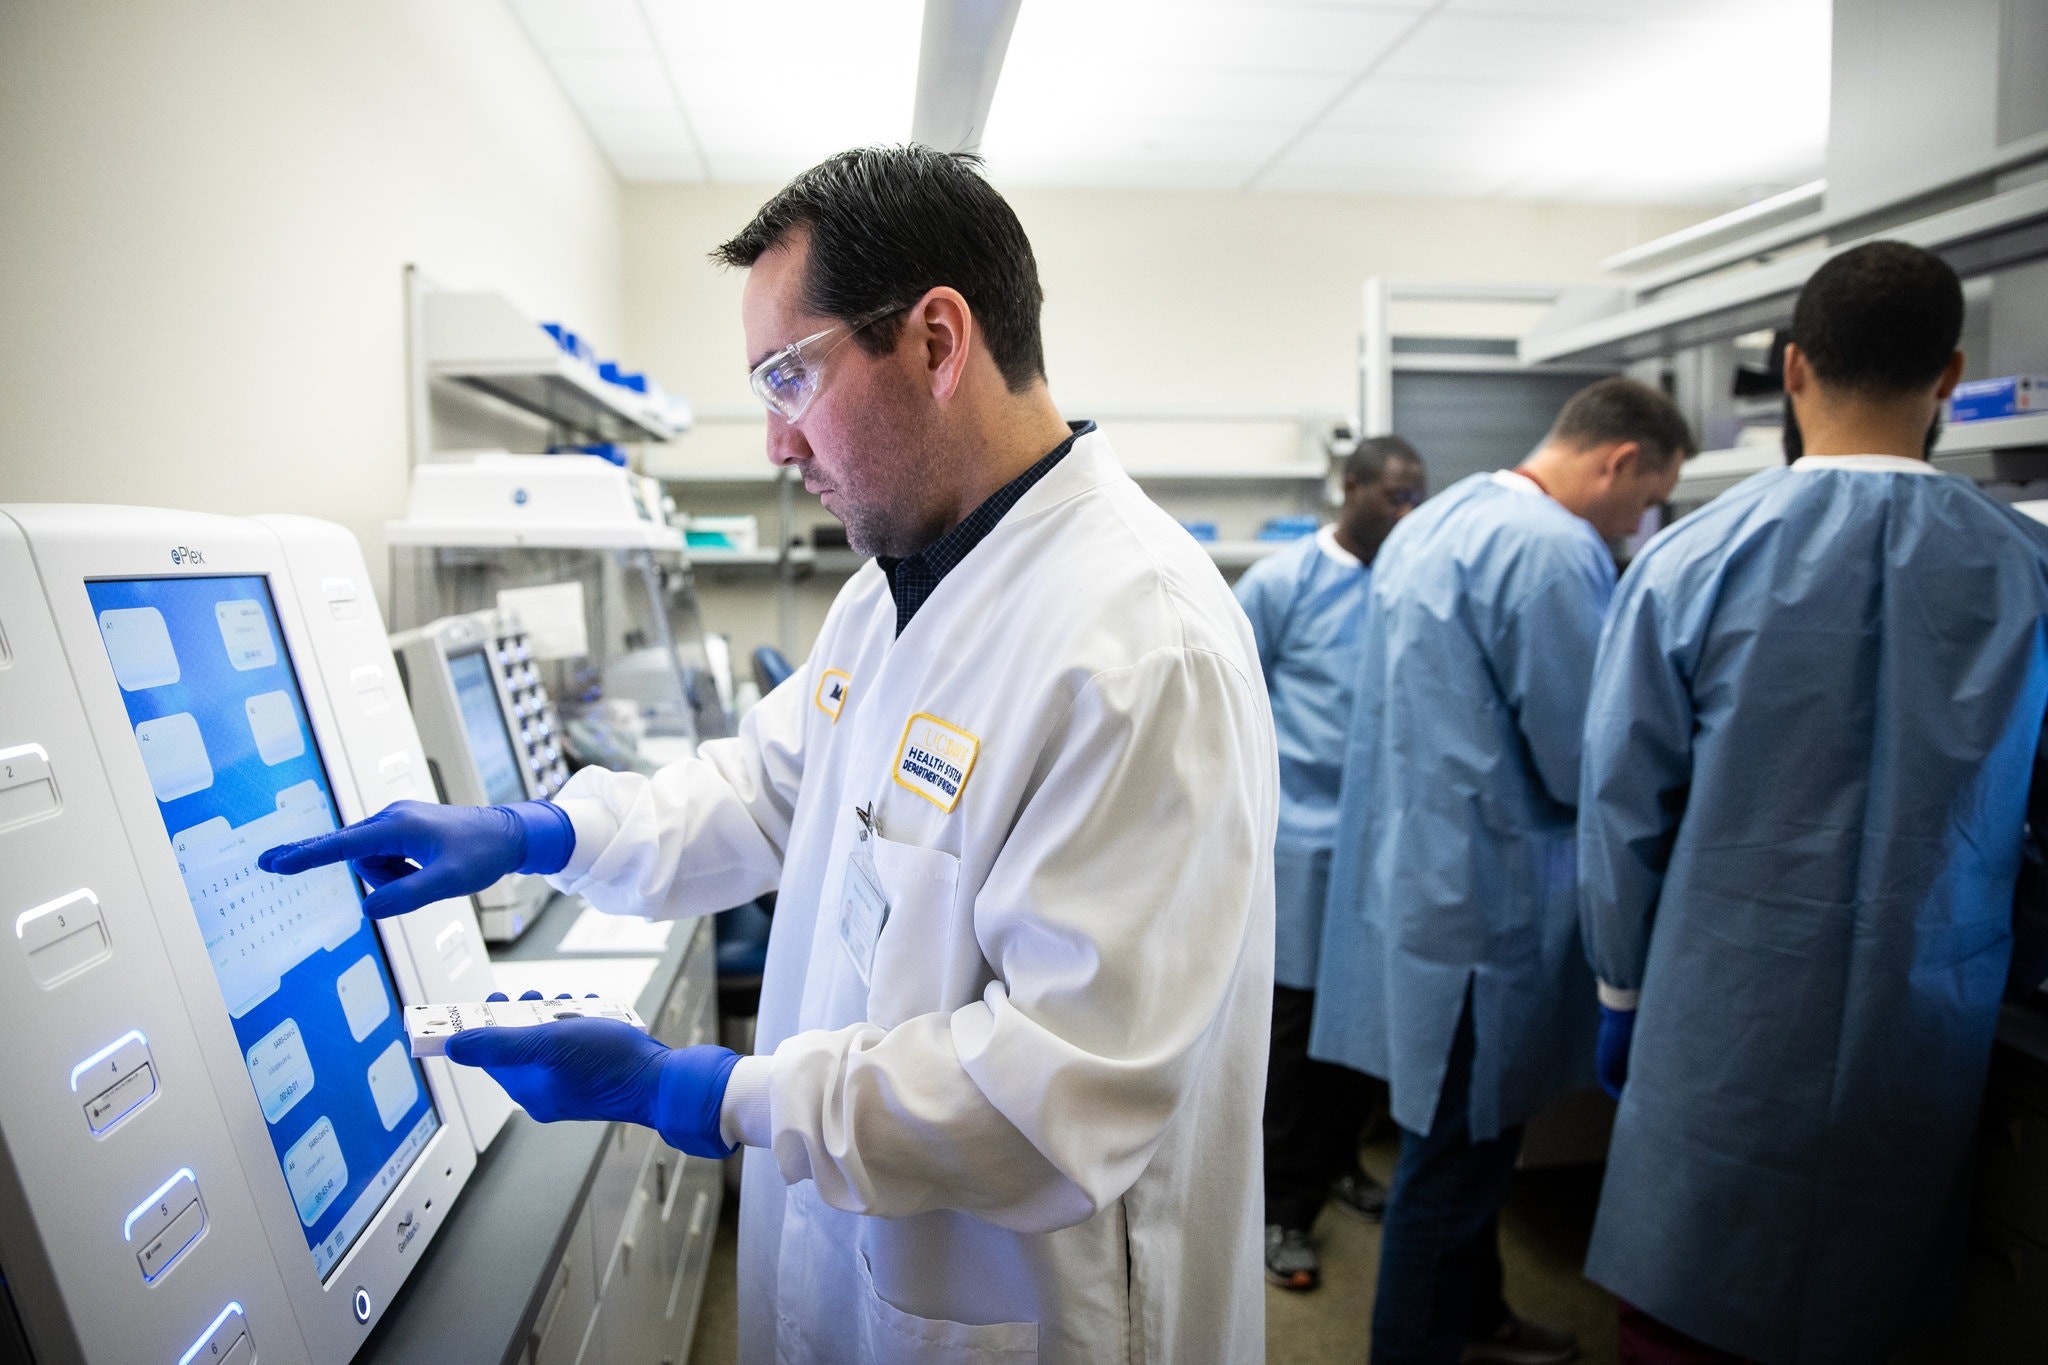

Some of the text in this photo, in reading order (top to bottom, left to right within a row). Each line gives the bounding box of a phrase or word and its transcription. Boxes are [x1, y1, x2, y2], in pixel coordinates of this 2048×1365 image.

[171, 546, 206, 565] ePlex
[908, 746, 946, 772] HEALTH
[5, 765, 14, 779] 2
[902, 759, 939, 785] DEPARTMENT
[57, 915, 67, 928] 3
[273, 1027, 296, 1050] SARS-CoV-2
[111, 1061, 118, 1073] 4
[308, 1125, 329, 1150] SARS-CoV-2
[161, 1203, 168, 1216] 5
[211, 1342, 218, 1355] 6
